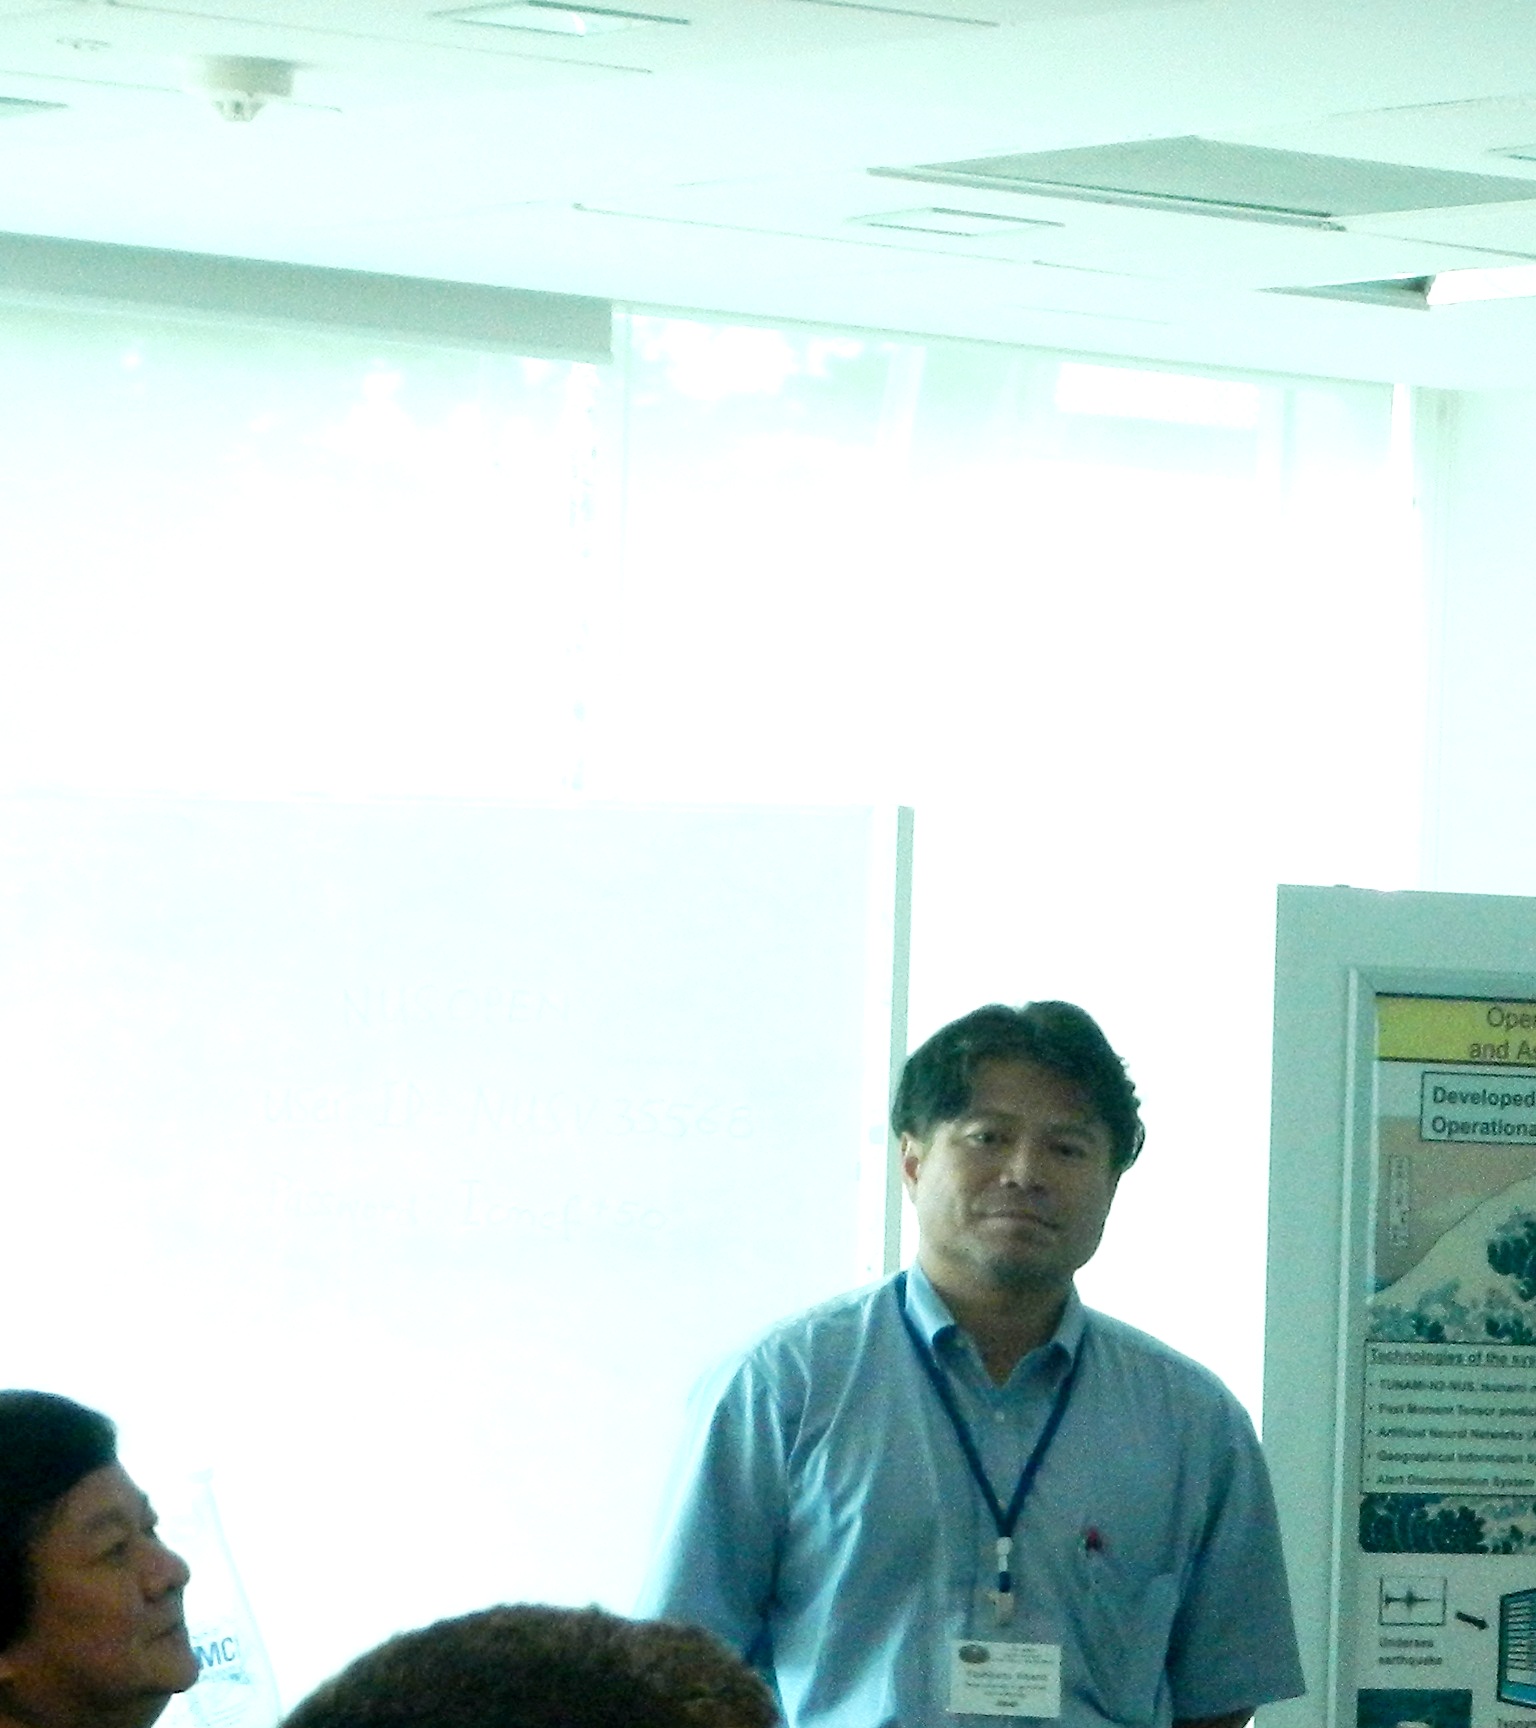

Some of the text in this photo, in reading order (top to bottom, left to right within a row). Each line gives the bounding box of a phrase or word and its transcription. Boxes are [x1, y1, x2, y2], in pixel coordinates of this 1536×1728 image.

[1469, 1041, 1510, 1060] and
[1432, 1086, 1536, 1112] Developed
[1370, 1349, 1464, 1366] Technologies
[1467, 1352, 1482, 1365] of
[1486, 1352, 1508, 1366] the
